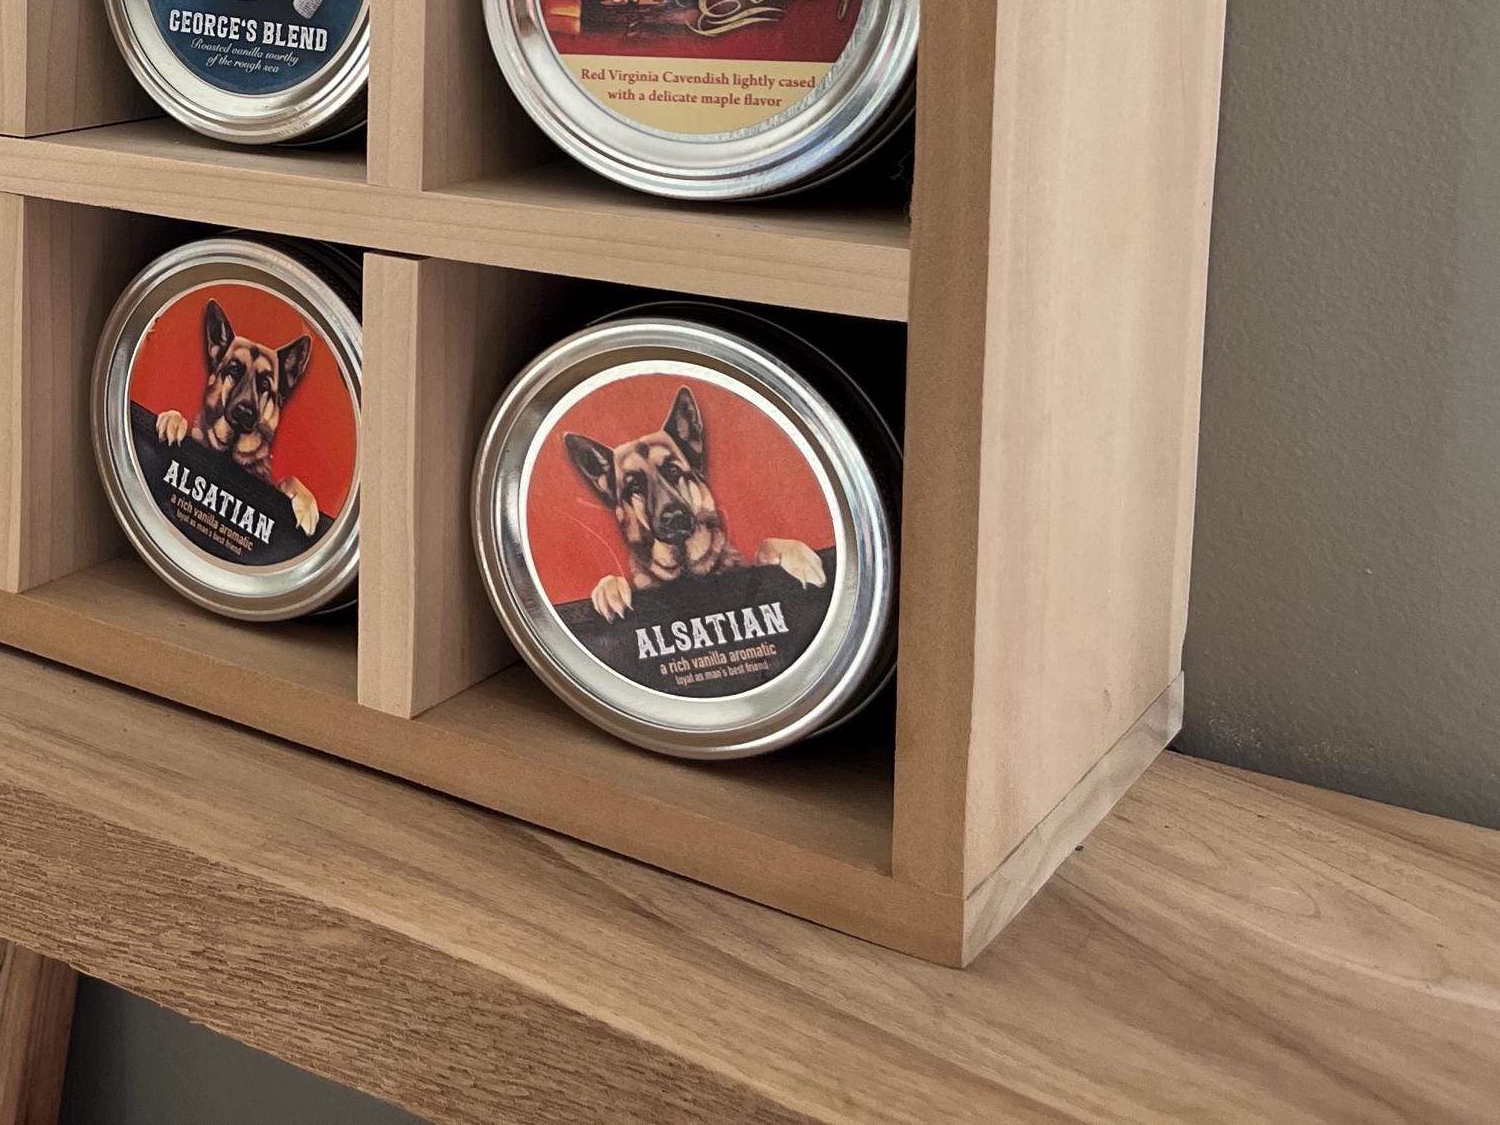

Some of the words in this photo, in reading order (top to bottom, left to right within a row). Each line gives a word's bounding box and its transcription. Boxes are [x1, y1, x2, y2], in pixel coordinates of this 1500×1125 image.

[169, 9, 257, 42] GEORGE'S
[262, 21, 328, 52] BLEND
[190, 37, 233, 54] Roasted
[232, 45, 262, 58] vanilla
[265, 50, 299, 66] worthy
[205, 53, 220, 67] of
[219, 56, 231, 66] the
[233, 60, 261, 73] rough
[263, 65, 279, 73] sea
[581, 68, 605, 82] Red
[608, 69, 659, 85] Virginia
[662, 70, 730, 86] Cavendish
[732, 73, 775, 90] lightly
[778, 76, 816, 89] cased
[607, 89, 636, 101] with
[638, 93, 645, 101] a
[648, 89, 698, 104] delicate
[700, 93, 741, 108] maple
[743, 93, 782, 108] flavor
[163, 459, 276, 544] ALSATIAN
[171, 493, 177, 504] a
[177, 496, 193, 514] rich
[193, 507, 219, 530] vanilla
[219, 523, 254, 551] aromatic
[635, 601, 790, 659] ALSATIAN
[660, 663, 668, 675] a
[668, 656, 691, 674] rich
[691, 650, 728, 669] vanilla
[729, 641, 778, 662] aromatic
